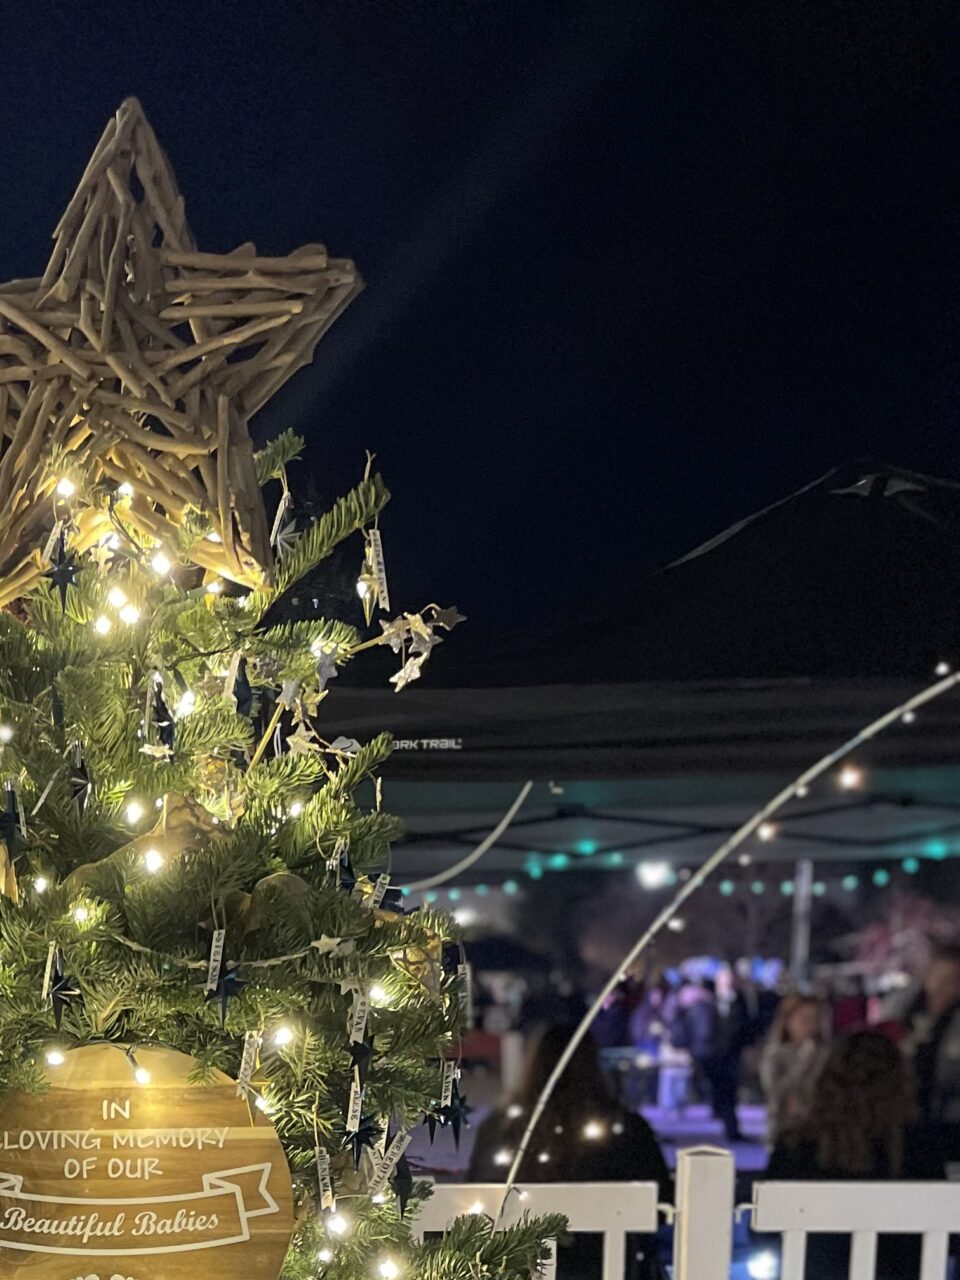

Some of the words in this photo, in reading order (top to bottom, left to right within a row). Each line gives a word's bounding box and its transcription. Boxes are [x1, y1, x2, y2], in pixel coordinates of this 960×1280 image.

[102, 1100, 130, 1120] IN
[3, 1129, 102, 1150] LOVING
[112, 1127, 230, 1149] MEMORY
[64, 1157, 98, 1179] OF
[107, 1157, 163, 1180] OUR
[0, 1207, 123, 1243] Beautiful
[132, 1209, 219, 1236] Babies
